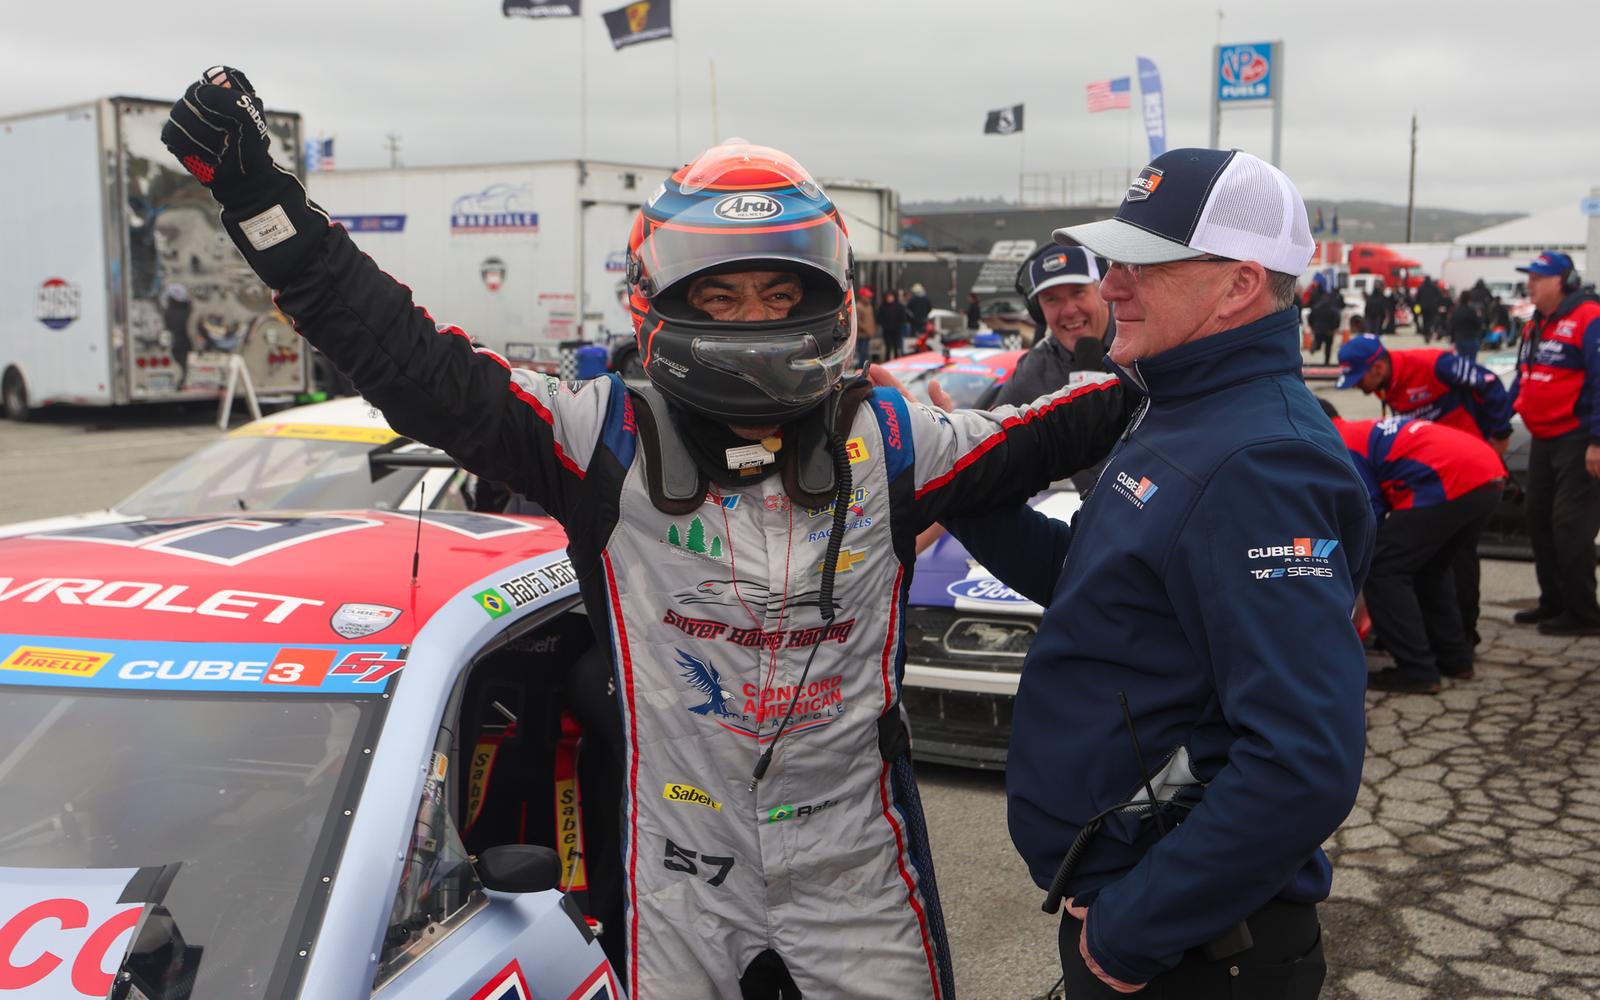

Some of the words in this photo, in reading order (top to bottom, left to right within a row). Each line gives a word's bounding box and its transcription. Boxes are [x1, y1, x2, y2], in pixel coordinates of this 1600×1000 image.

[1222, 84, 1267, 98] FUELS
[236, 95, 268, 140] Sabelt
[720, 197, 775, 214] Arai
[258, 225, 278, 236] Sabelt
[879, 400, 903, 450] Sabelt
[1116, 471, 1144, 496] CUBE3
[1247, 545, 1306, 559] CUBE3
[501, 572, 550, 607] Rafa
[538, 559, 578, 590] Mat
[1287, 566, 1333, 578] SERIES
[663, 608, 730, 641] Silver
[784, 617, 856, 649] Racing
[11, 651, 101, 672] PIRELLI
[327, 651, 407, 684] 57
[742, 675, 843, 702] CONCORD
[743, 688, 842, 719] AMERICAN
[664, 839, 735, 887] 57
